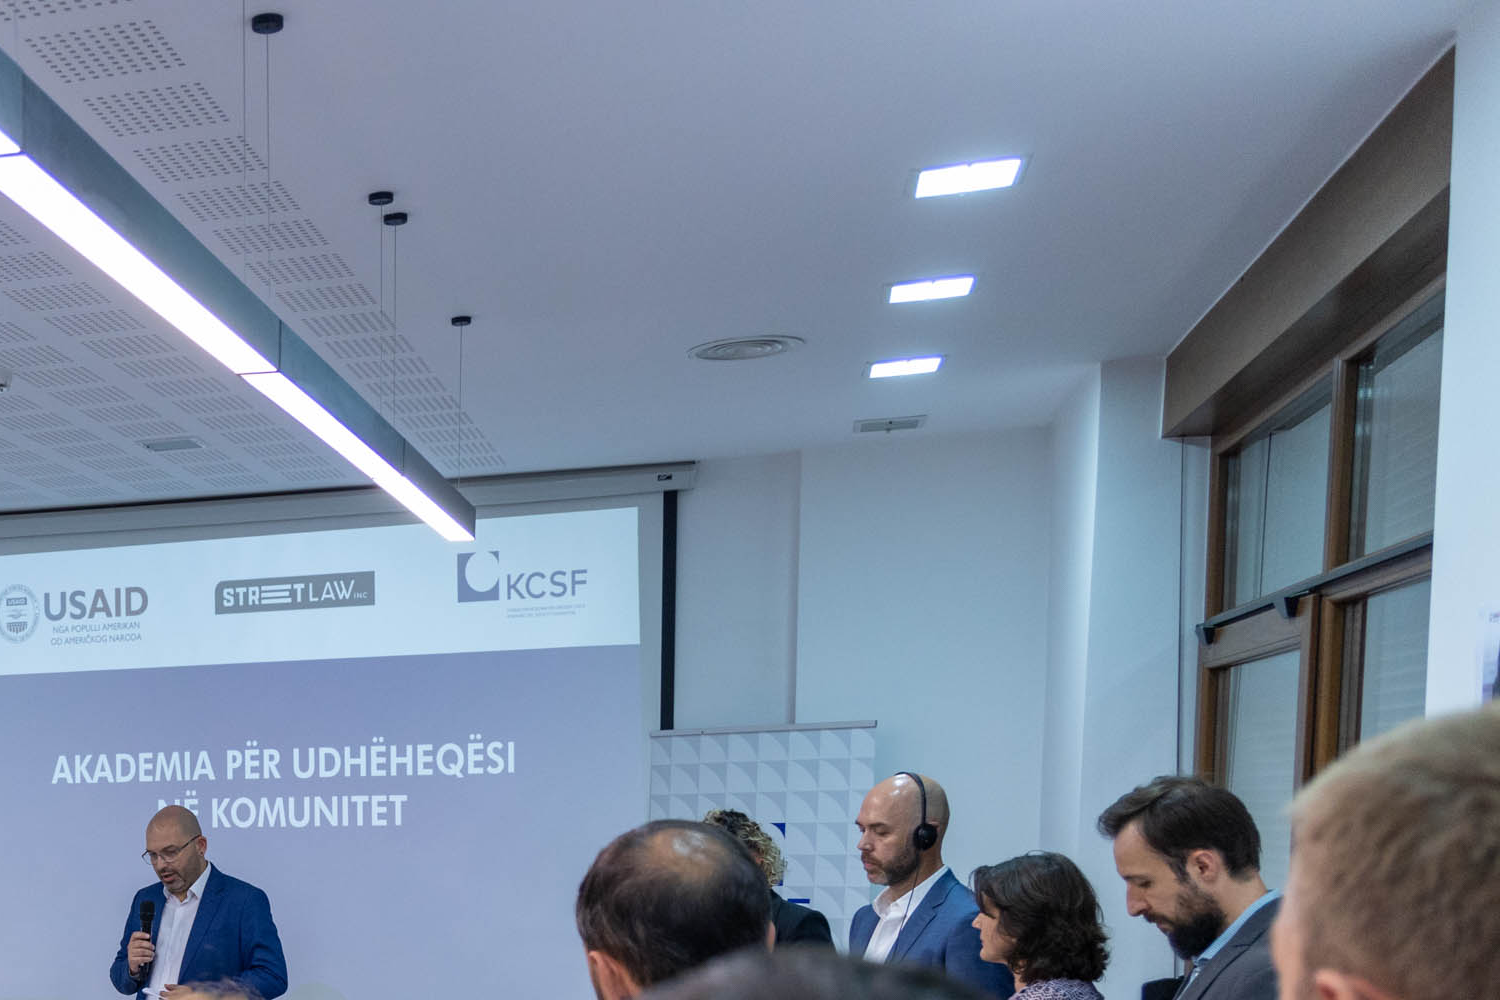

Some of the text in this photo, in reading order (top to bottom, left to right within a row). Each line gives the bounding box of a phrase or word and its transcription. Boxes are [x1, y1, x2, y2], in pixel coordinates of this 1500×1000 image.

[506, 569, 588, 600] KCSF
[44, 586, 149, 621] USAID
[52, 625, 70, 634] NGA
[102, 621, 140, 631] AMERIKAN
[51, 734, 516, 785] AKADEMIA PËR UDHËHEQËSI
[211, 794, 409, 829] KOMUNITET
